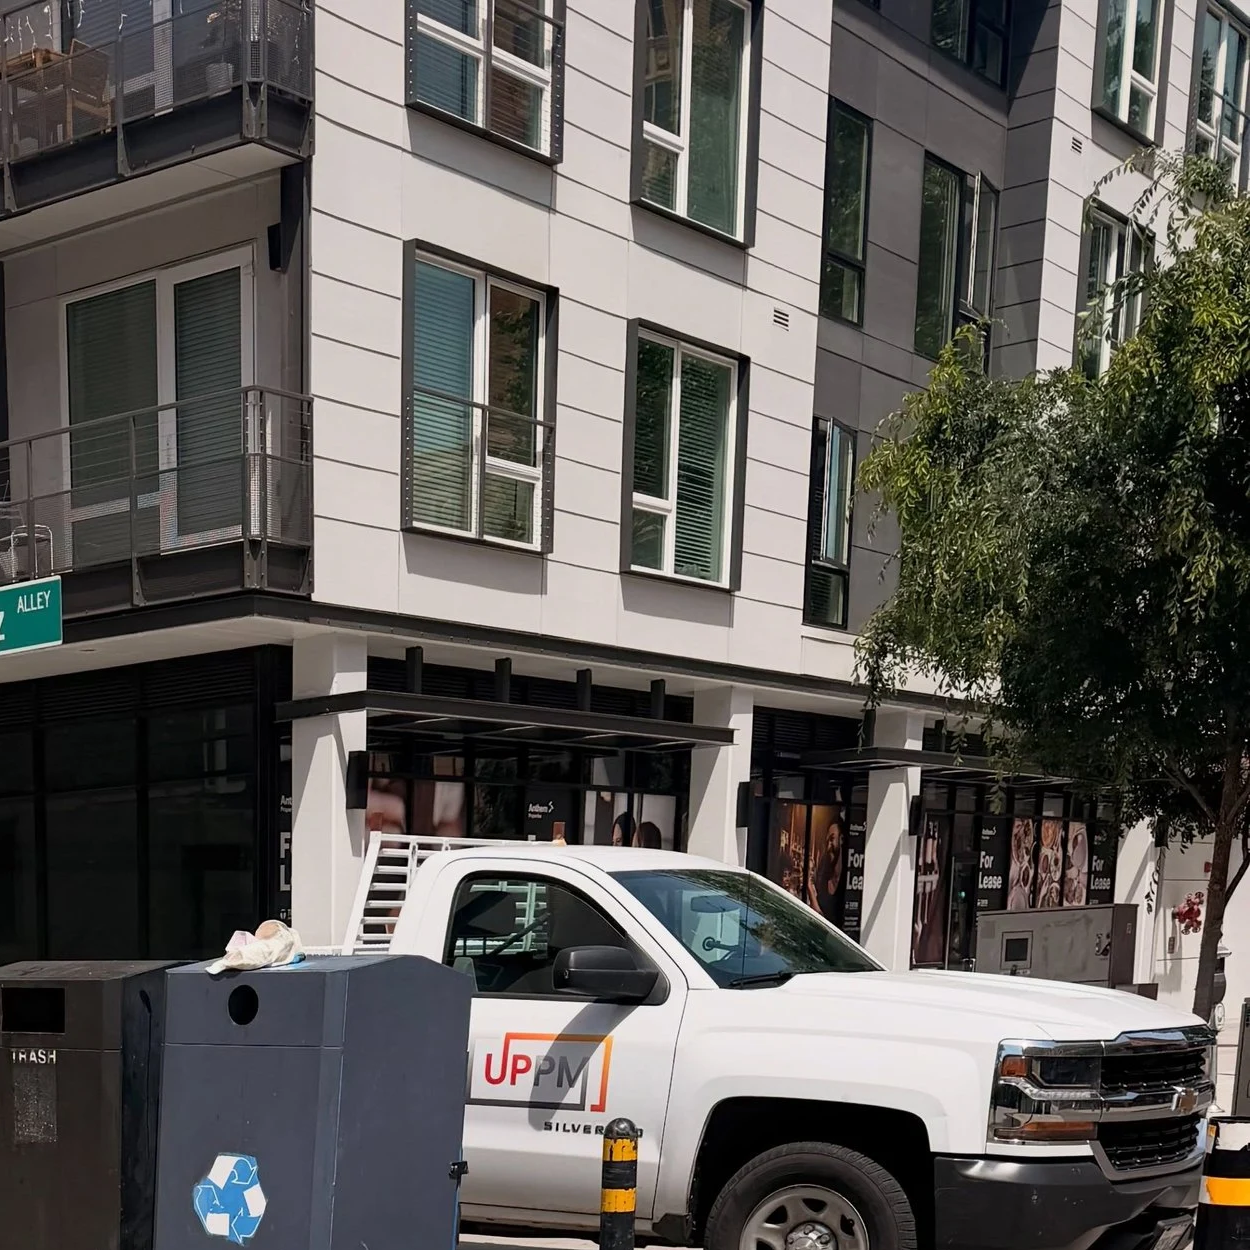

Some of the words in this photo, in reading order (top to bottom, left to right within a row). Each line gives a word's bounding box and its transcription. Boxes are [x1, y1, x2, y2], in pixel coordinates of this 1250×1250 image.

[17, 590, 51, 614] ALLEY
[848, 848, 864, 868] For
[979, 851, 994, 868] For
[1092, 855, 1104, 871] For
[846, 871, 863, 890] Lea
[978, 871, 1002, 889] Lease
[1090, 874, 1110, 890] Lease
[11, 1048, 56, 1064] TRASH
